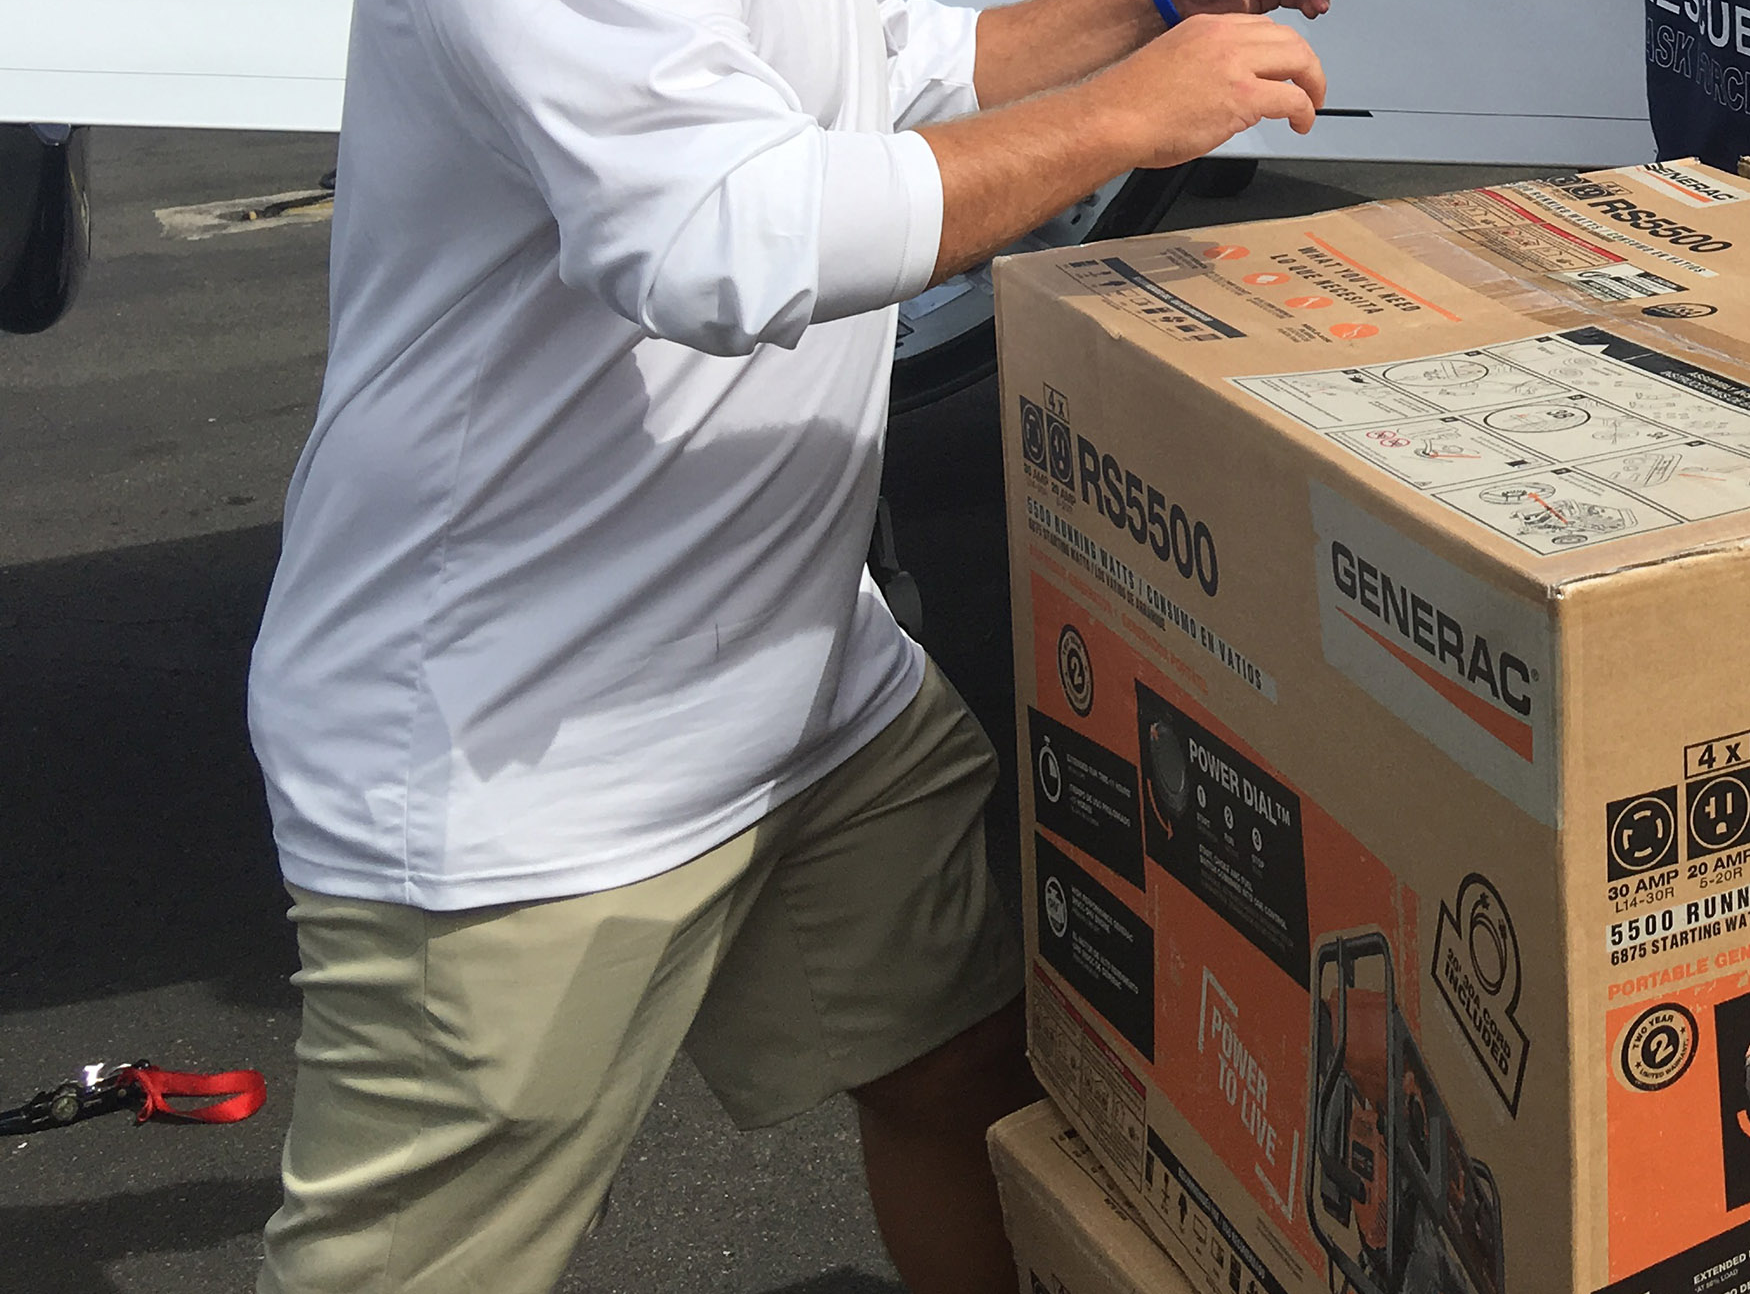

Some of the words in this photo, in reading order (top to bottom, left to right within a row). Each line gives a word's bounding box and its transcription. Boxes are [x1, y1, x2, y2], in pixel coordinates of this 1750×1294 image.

[1587, 198, 1733, 253] RS5500
[1290, 263, 1322, 280] QUE
[1319, 279, 1384, 314] NECESITA
[1297, 246, 1343, 268] WHAT
[1378, 290, 1421, 312] NEED
[1077, 434, 1219, 598] RS5500
[1331, 540, 1531, 716] GENERAC
[1189, 738, 1240, 799] POWER
[1698, 744, 1717, 769] 4
[1608, 883, 1631, 901] 30
[1634, 869, 1679, 895] AMP
[1687, 861, 1709, 879] 20
[1610, 909, 1674, 946] 5500
[1611, 941, 1647, 966] 6875
[1651, 923, 1721, 955] STARTING
[1608, 953, 1709, 1000] PORTABLE
[1443, 959, 1511, 1077] INCLUDED
[1632, 1027, 1647, 1050] TWO
[1649, 1015, 1674, 1026] YEAR
[1211, 1006, 1268, 1111] POWER
[1650, 1033, 1674, 1064] 2
[1217, 1053, 1237, 1106] TO
[1241, 1099, 1277, 1166] LIVE
[1693, 1252, 1747, 1284] EXTENDED
